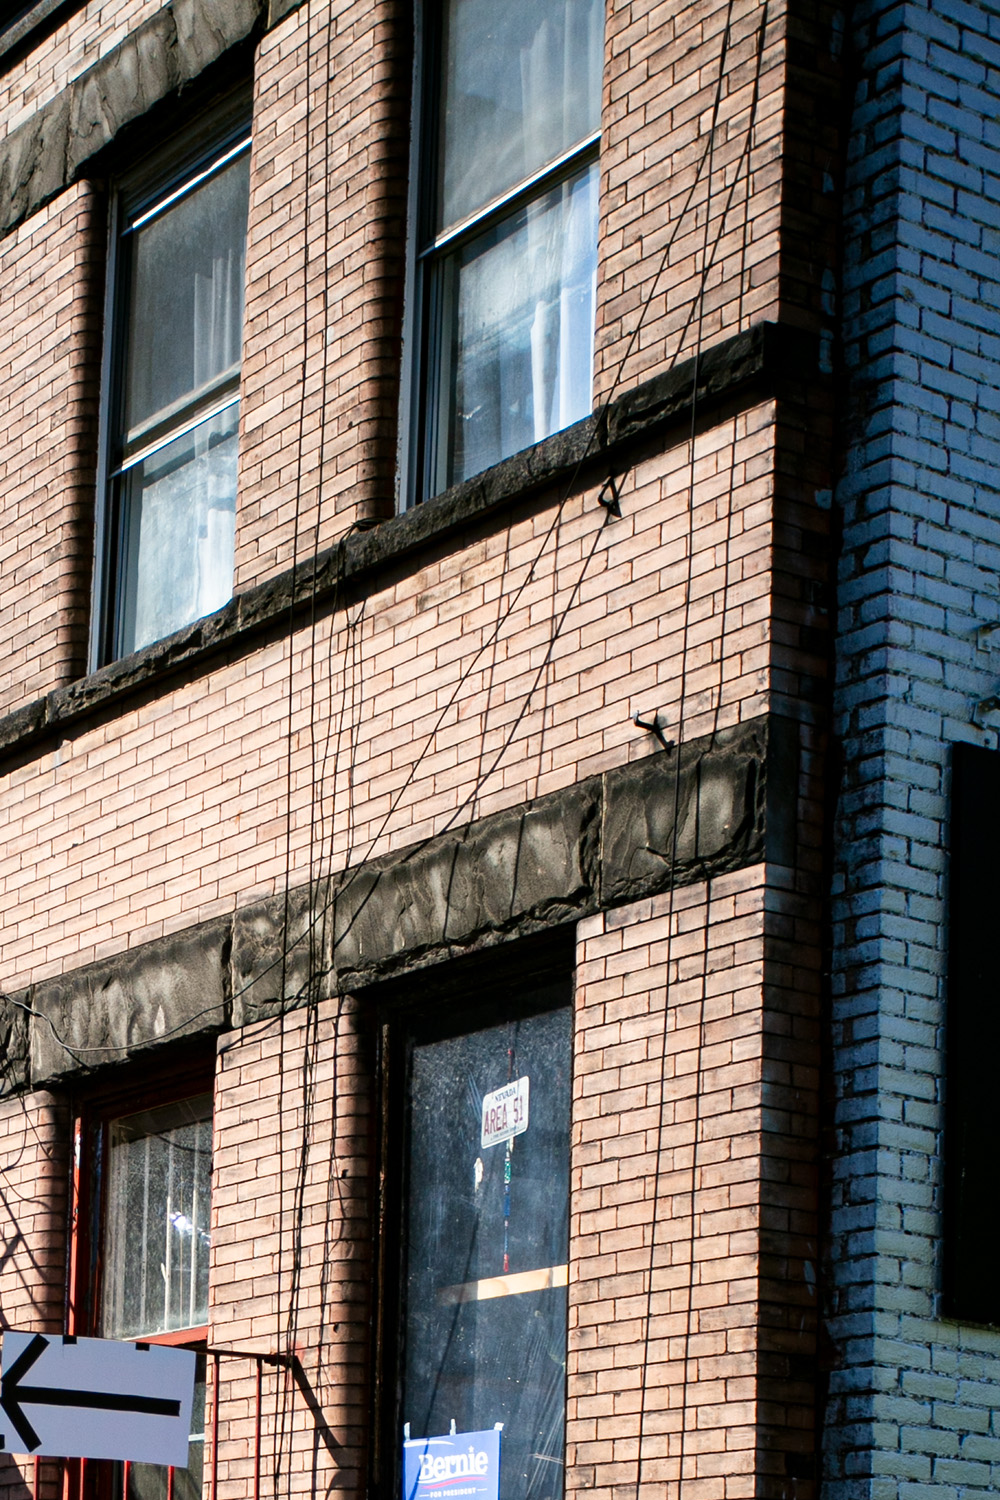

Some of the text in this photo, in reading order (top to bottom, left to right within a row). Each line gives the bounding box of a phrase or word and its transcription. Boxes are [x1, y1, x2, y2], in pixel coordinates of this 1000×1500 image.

[495, 1087, 516, 1101] NEVADA
[484, 1103, 508, 1136] AREA
[513, 1095, 524, 1123] 51
[418, 1447, 489, 1480] Bernie
[443, 1487, 476, 1497] PRESIDENT
